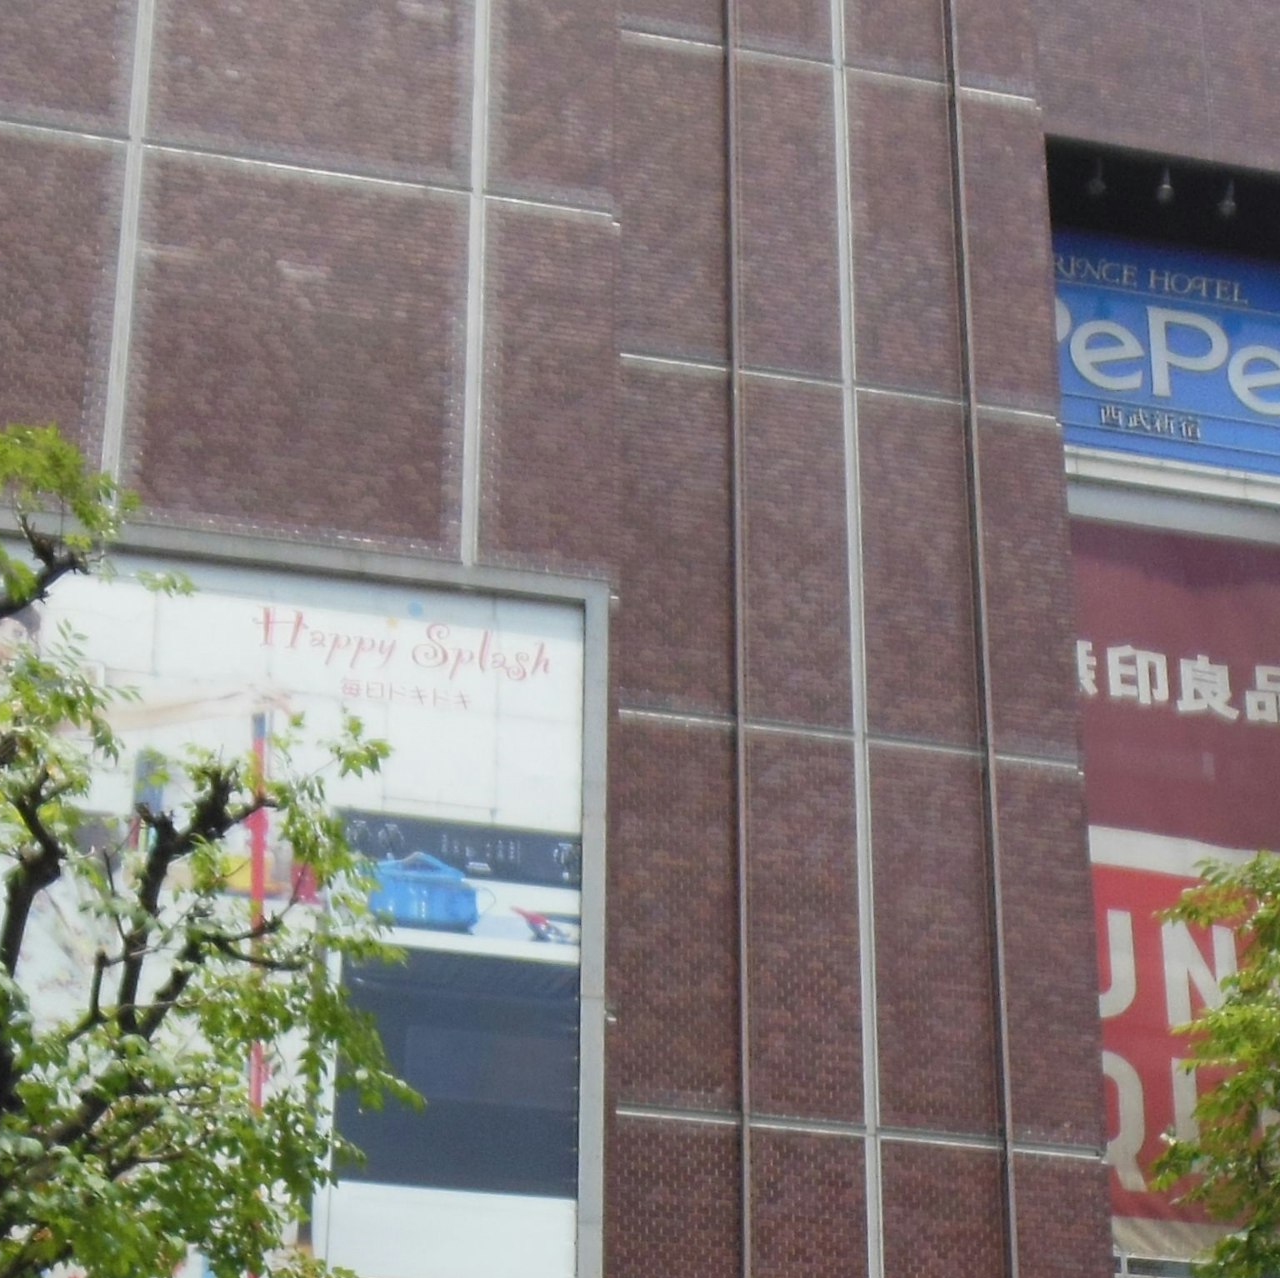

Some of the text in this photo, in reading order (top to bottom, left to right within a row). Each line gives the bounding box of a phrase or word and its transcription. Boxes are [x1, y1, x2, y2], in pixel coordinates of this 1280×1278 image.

[1149, 269, 1249, 304] HOTEL
[1100, 404, 1202, 440] 西武新宿
[252, 605, 551, 681] Happy Splash
[340, 677, 472, 710] 毎日ドキドキ
